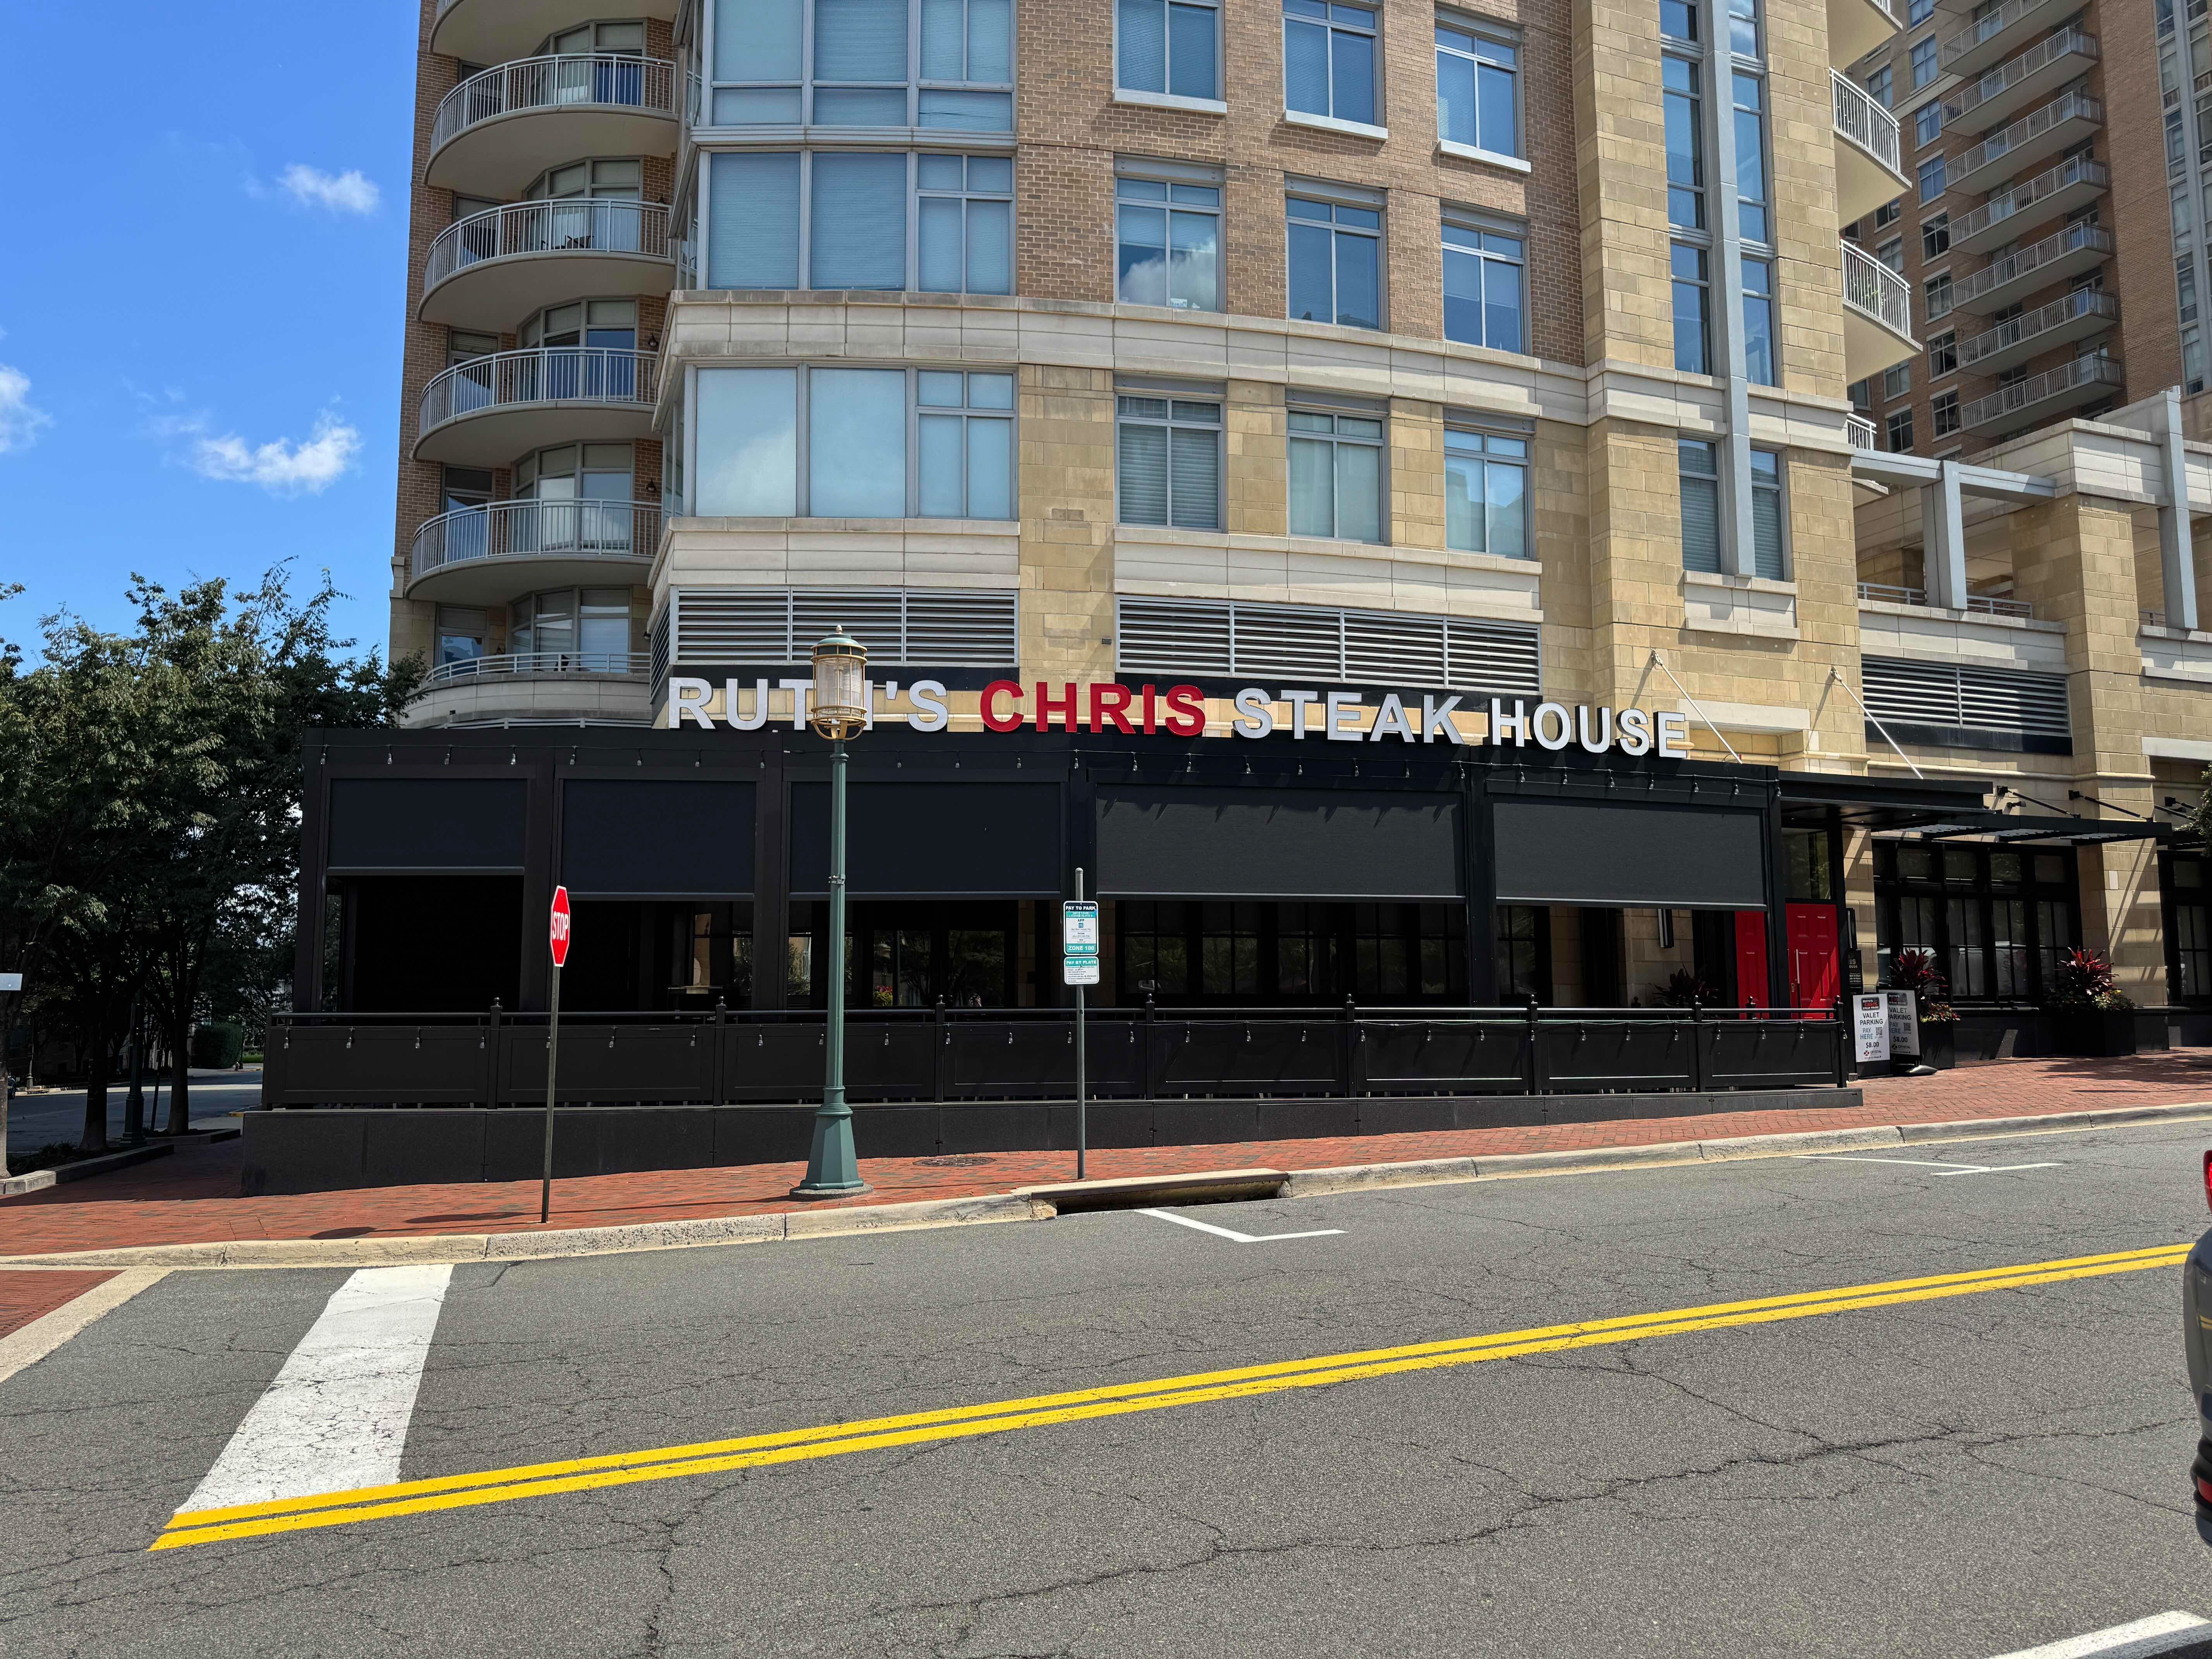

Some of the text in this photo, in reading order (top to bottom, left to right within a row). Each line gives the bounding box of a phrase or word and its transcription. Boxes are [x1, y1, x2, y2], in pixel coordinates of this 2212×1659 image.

[980, 680, 1206, 736] CHRIS
[1232, 688, 1464, 744] STEAK
[1487, 697, 1688, 758] HOUSE
[553, 911, 568, 941] STOP
